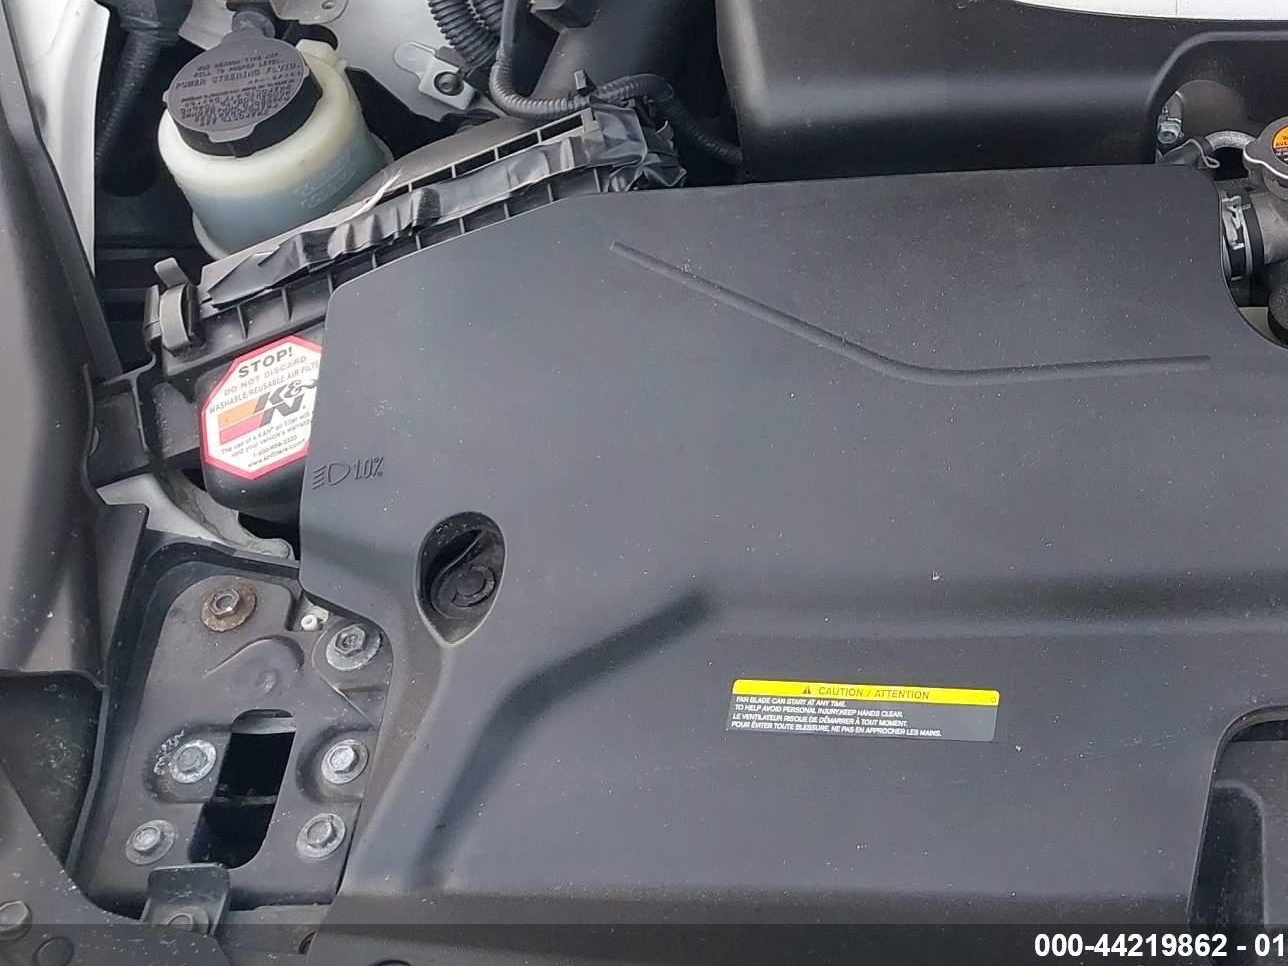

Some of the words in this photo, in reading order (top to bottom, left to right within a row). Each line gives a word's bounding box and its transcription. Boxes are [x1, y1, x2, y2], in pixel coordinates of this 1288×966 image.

[176, 78, 206, 89] POWER
[212, 70, 260, 83] STEERING
[224, 385, 238, 396] DO
[240, 377, 260, 388] NOT
[264, 356, 307, 379] DISCARD
[238, 346, 293, 378] STOP!
[209, 378, 286, 414] WASHABLE/REUSABLE
[287, 369, 300, 380] AIR
[301, 361, 320, 374] FILTE
[253, 380, 318, 428] K&N
[221, 446, 233, 455] The
[818, 687, 863, 697] CAUTION
[874, 689, 929, 700] ATTENTION
